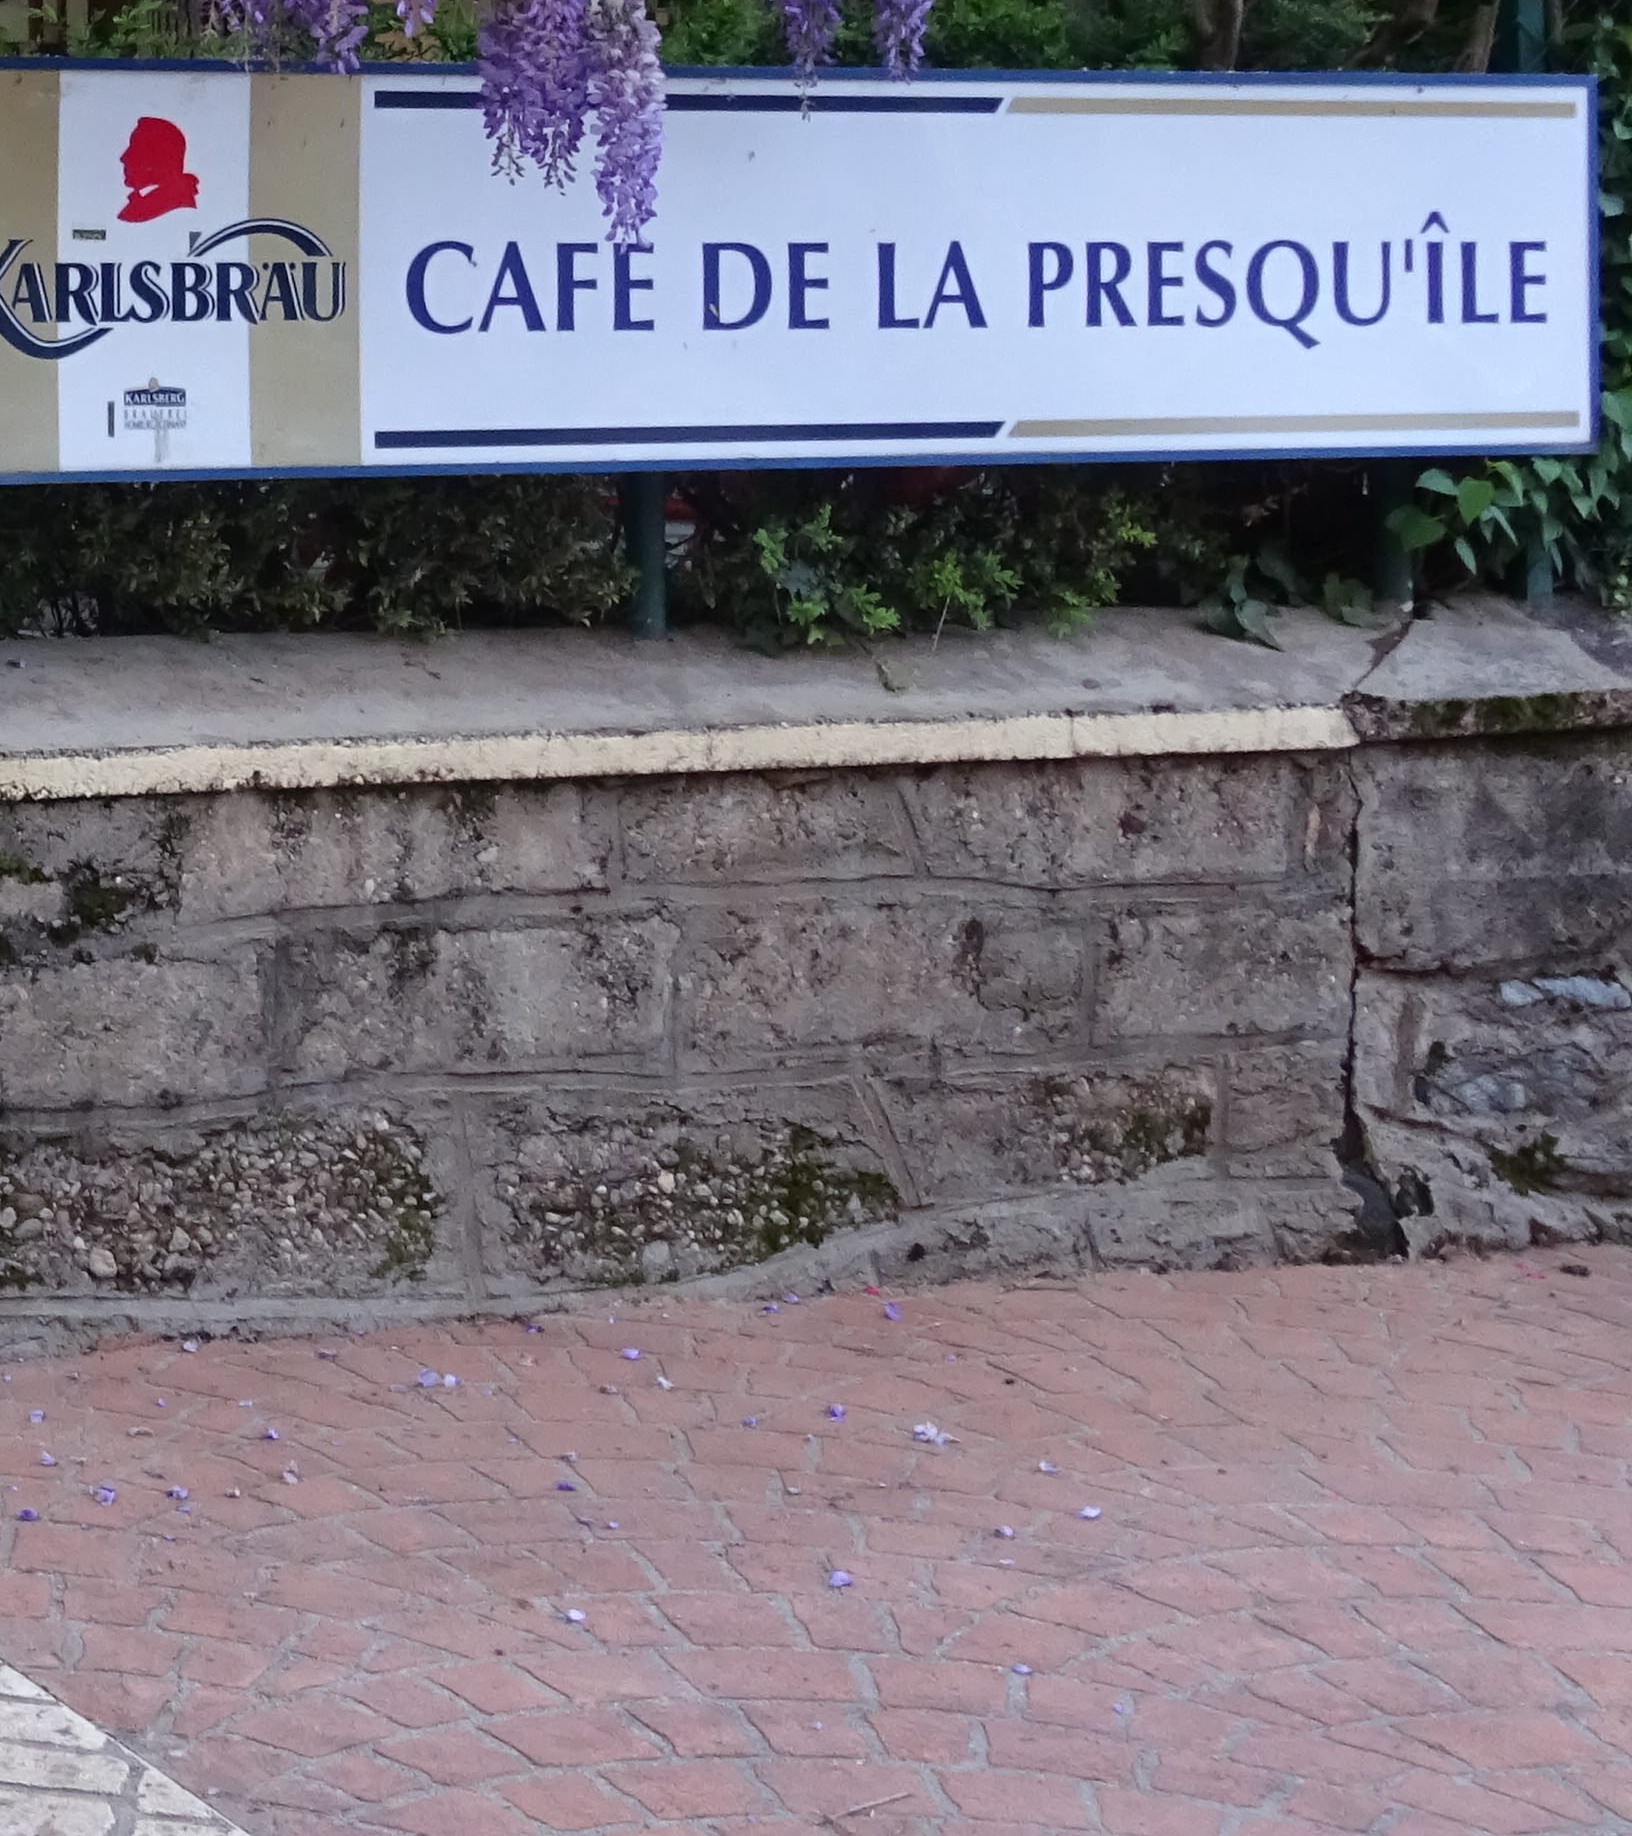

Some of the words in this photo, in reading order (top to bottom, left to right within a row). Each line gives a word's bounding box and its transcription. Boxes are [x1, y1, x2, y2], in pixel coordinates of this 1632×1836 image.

[405, 240, 655, 334] CAFE
[702, 242, 830, 331] DE
[877, 240, 988, 329] LA
[1028, 211, 1547, 349] PRESQU'ÎLE
